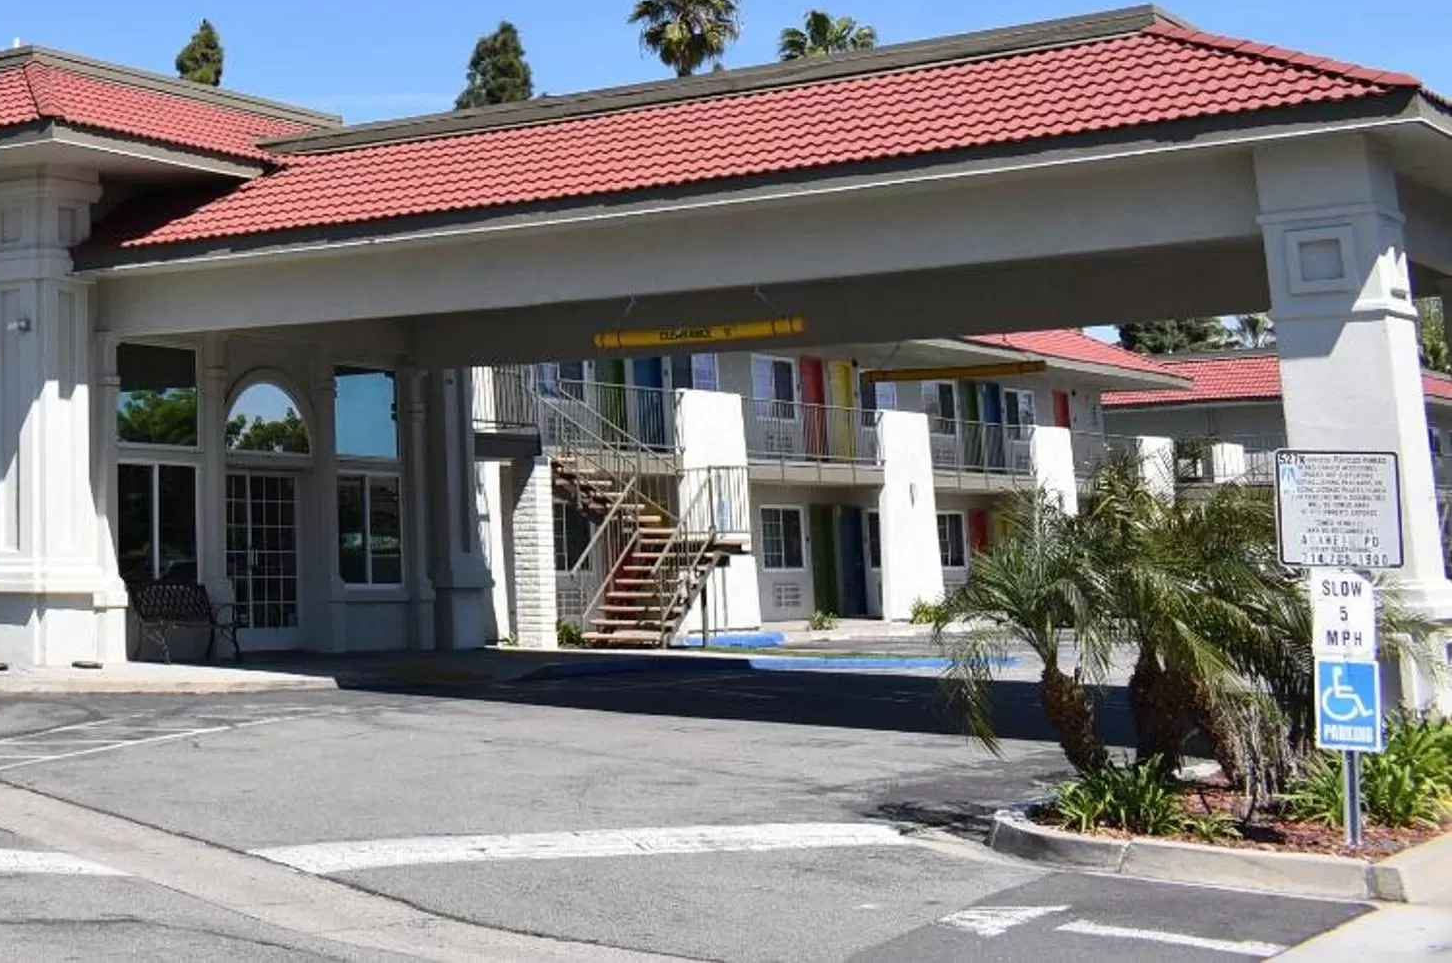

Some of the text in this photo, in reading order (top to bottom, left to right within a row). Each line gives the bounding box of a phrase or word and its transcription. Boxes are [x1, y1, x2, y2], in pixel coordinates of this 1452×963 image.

[1322, 579, 1362, 596] SLOW
[1339, 605, 1348, 621] 5
[1326, 629, 1362, 646] MPH
[1323, 724, 1373, 742] PARKING
